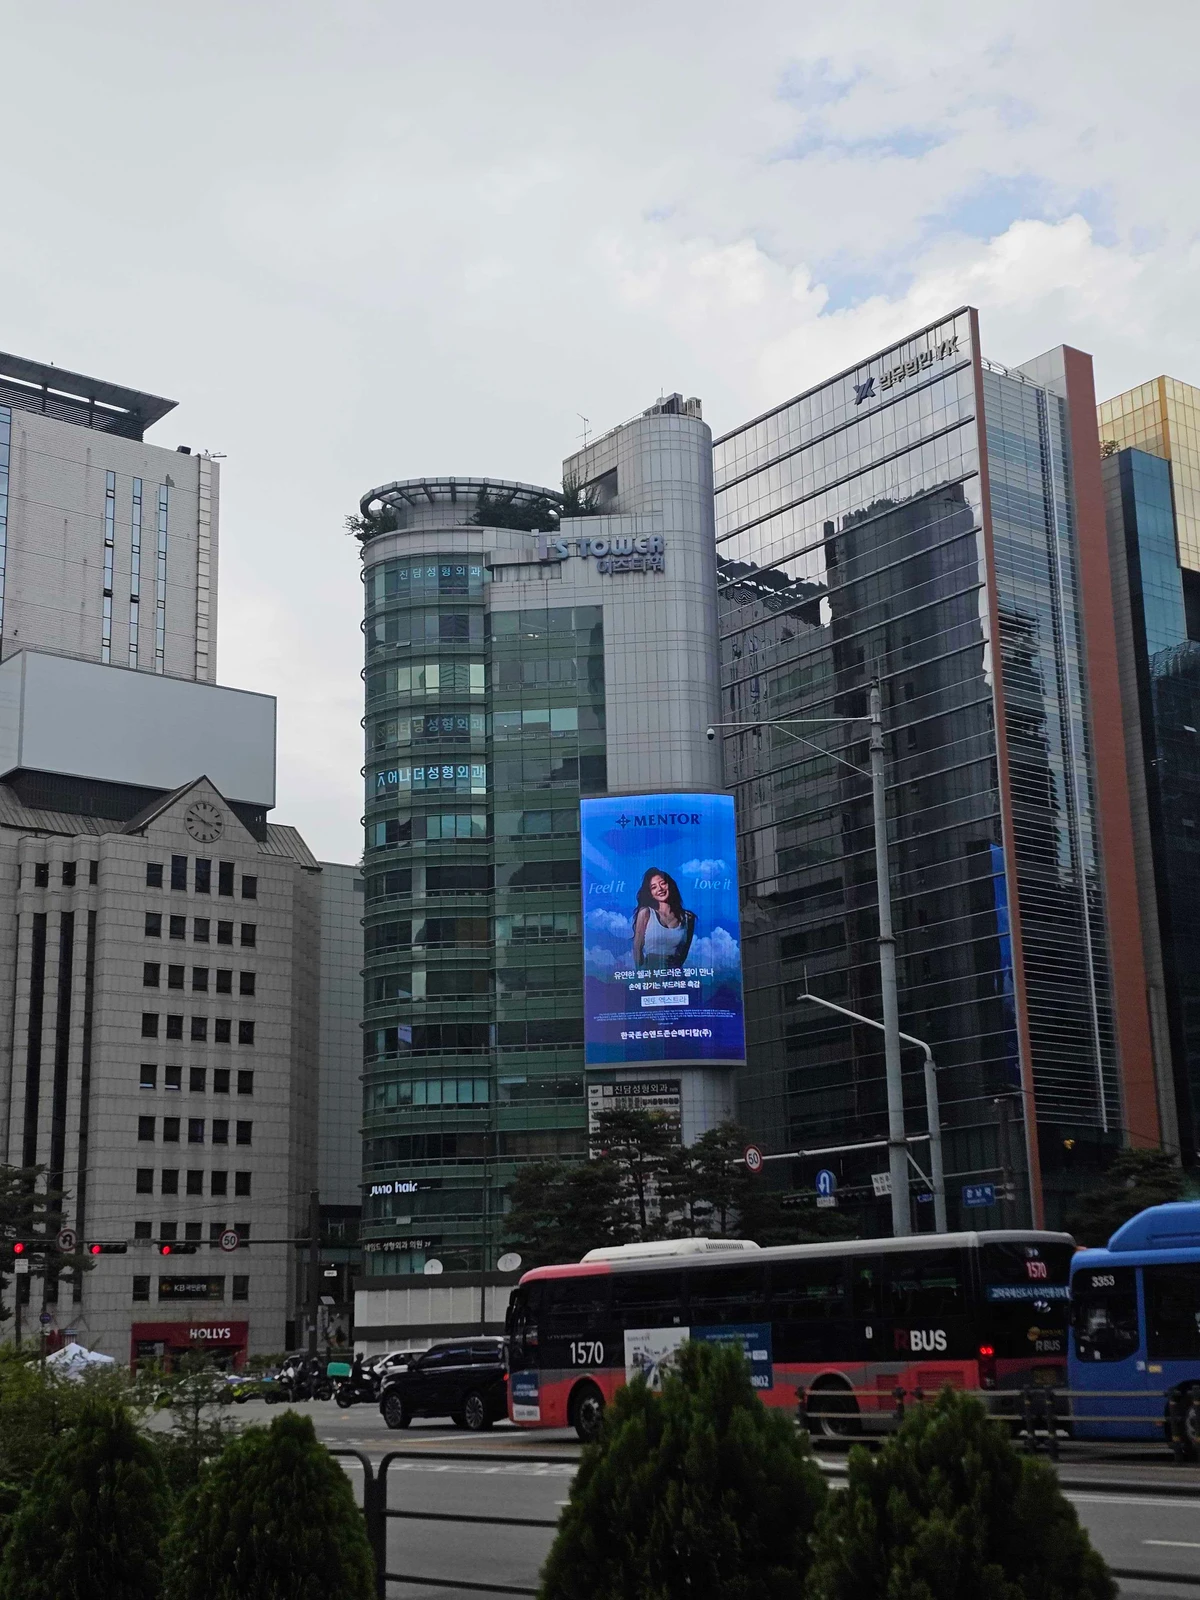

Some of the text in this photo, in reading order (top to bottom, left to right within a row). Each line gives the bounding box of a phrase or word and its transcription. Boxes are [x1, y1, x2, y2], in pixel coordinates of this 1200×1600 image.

[880, 335, 959, 391] 법무법인 YK
[576, 534, 665, 558] TOWER
[399, 565, 481, 581] 진담성형외과
[633, 813, 701, 827] MENTOR
[588, 878, 733, 895] Feel it Love it
[613, 971, 635, 980] 유연한
[653, 969, 682, 978] 부드러운
[699, 968, 714, 977] 만나
[661, 981, 687, 989] 부드러운
[614, 1083, 668, 1096] 진담성형외과
[748, 1153, 759, 1165] 50
[223, 1235, 236, 1246] 50
[1025, 1261, 1048, 1279] 1570
[1091, 1275, 1116, 1288] 3353
[189, 1327, 231, 1340] HOLLYS
[569, 1341, 605, 1365] 1570
